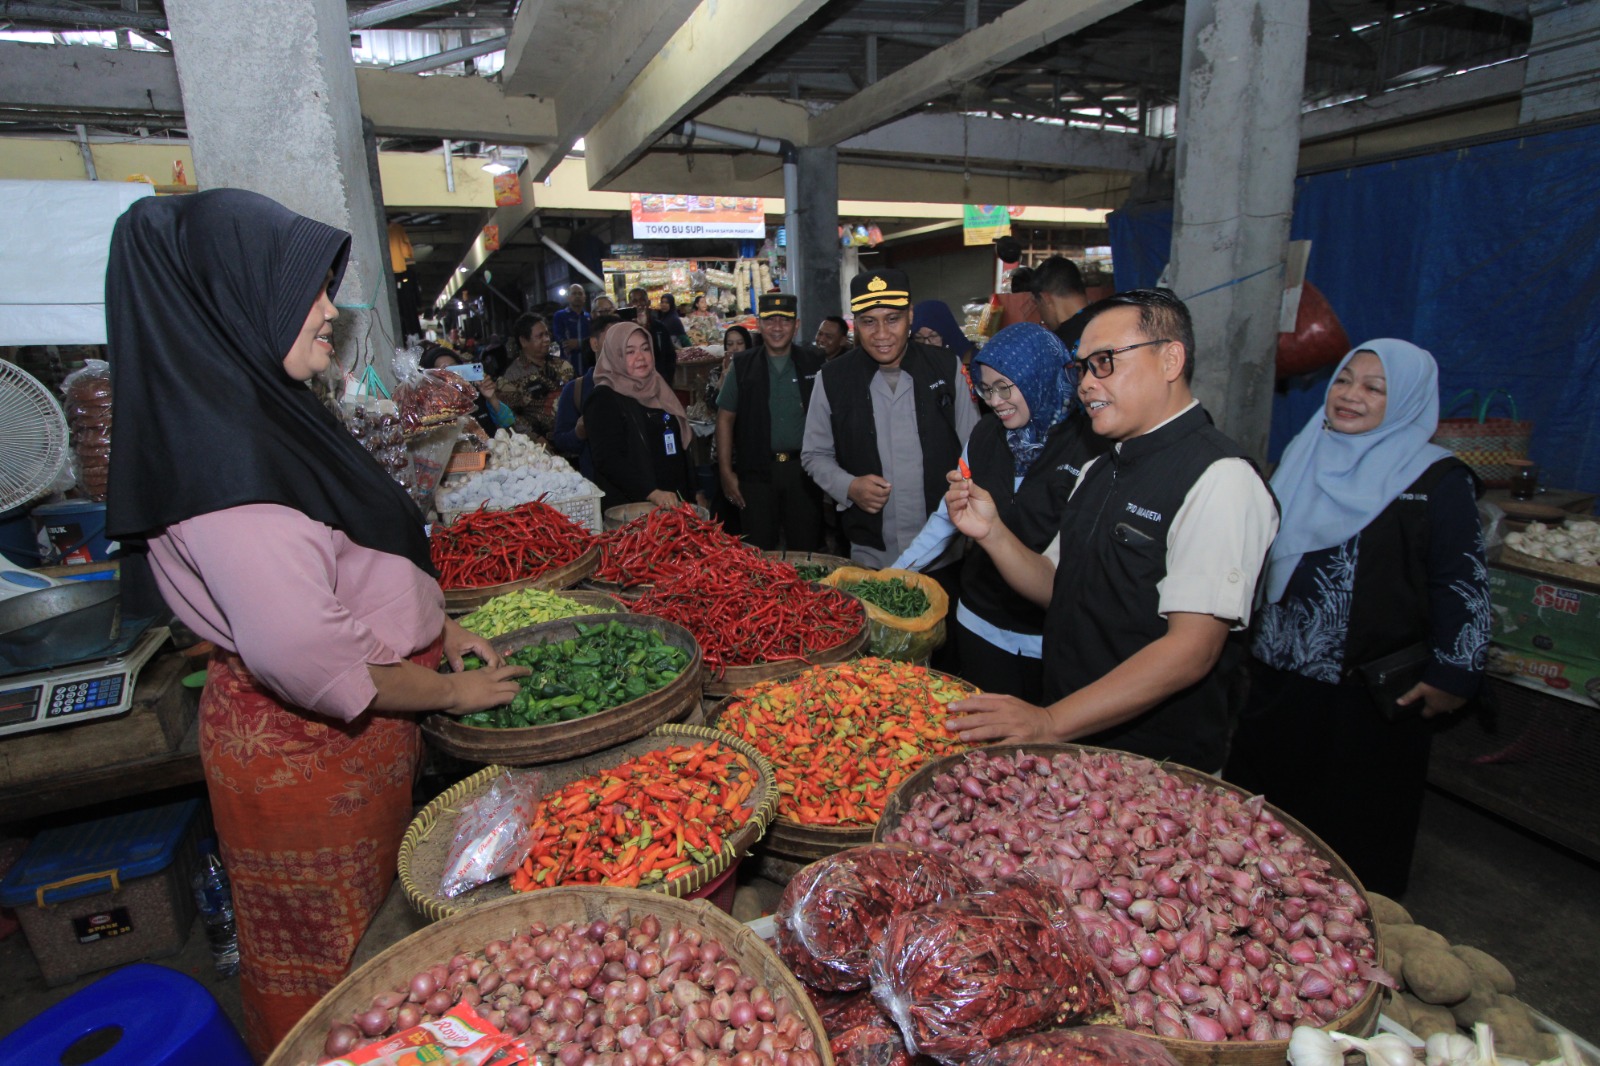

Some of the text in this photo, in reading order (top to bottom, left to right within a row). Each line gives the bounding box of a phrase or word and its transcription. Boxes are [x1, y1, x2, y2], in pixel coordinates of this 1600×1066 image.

[646, 226, 670, 234] TOKO
[672, 226, 684, 234] BU
[1532, 584, 1580, 616] SUN
